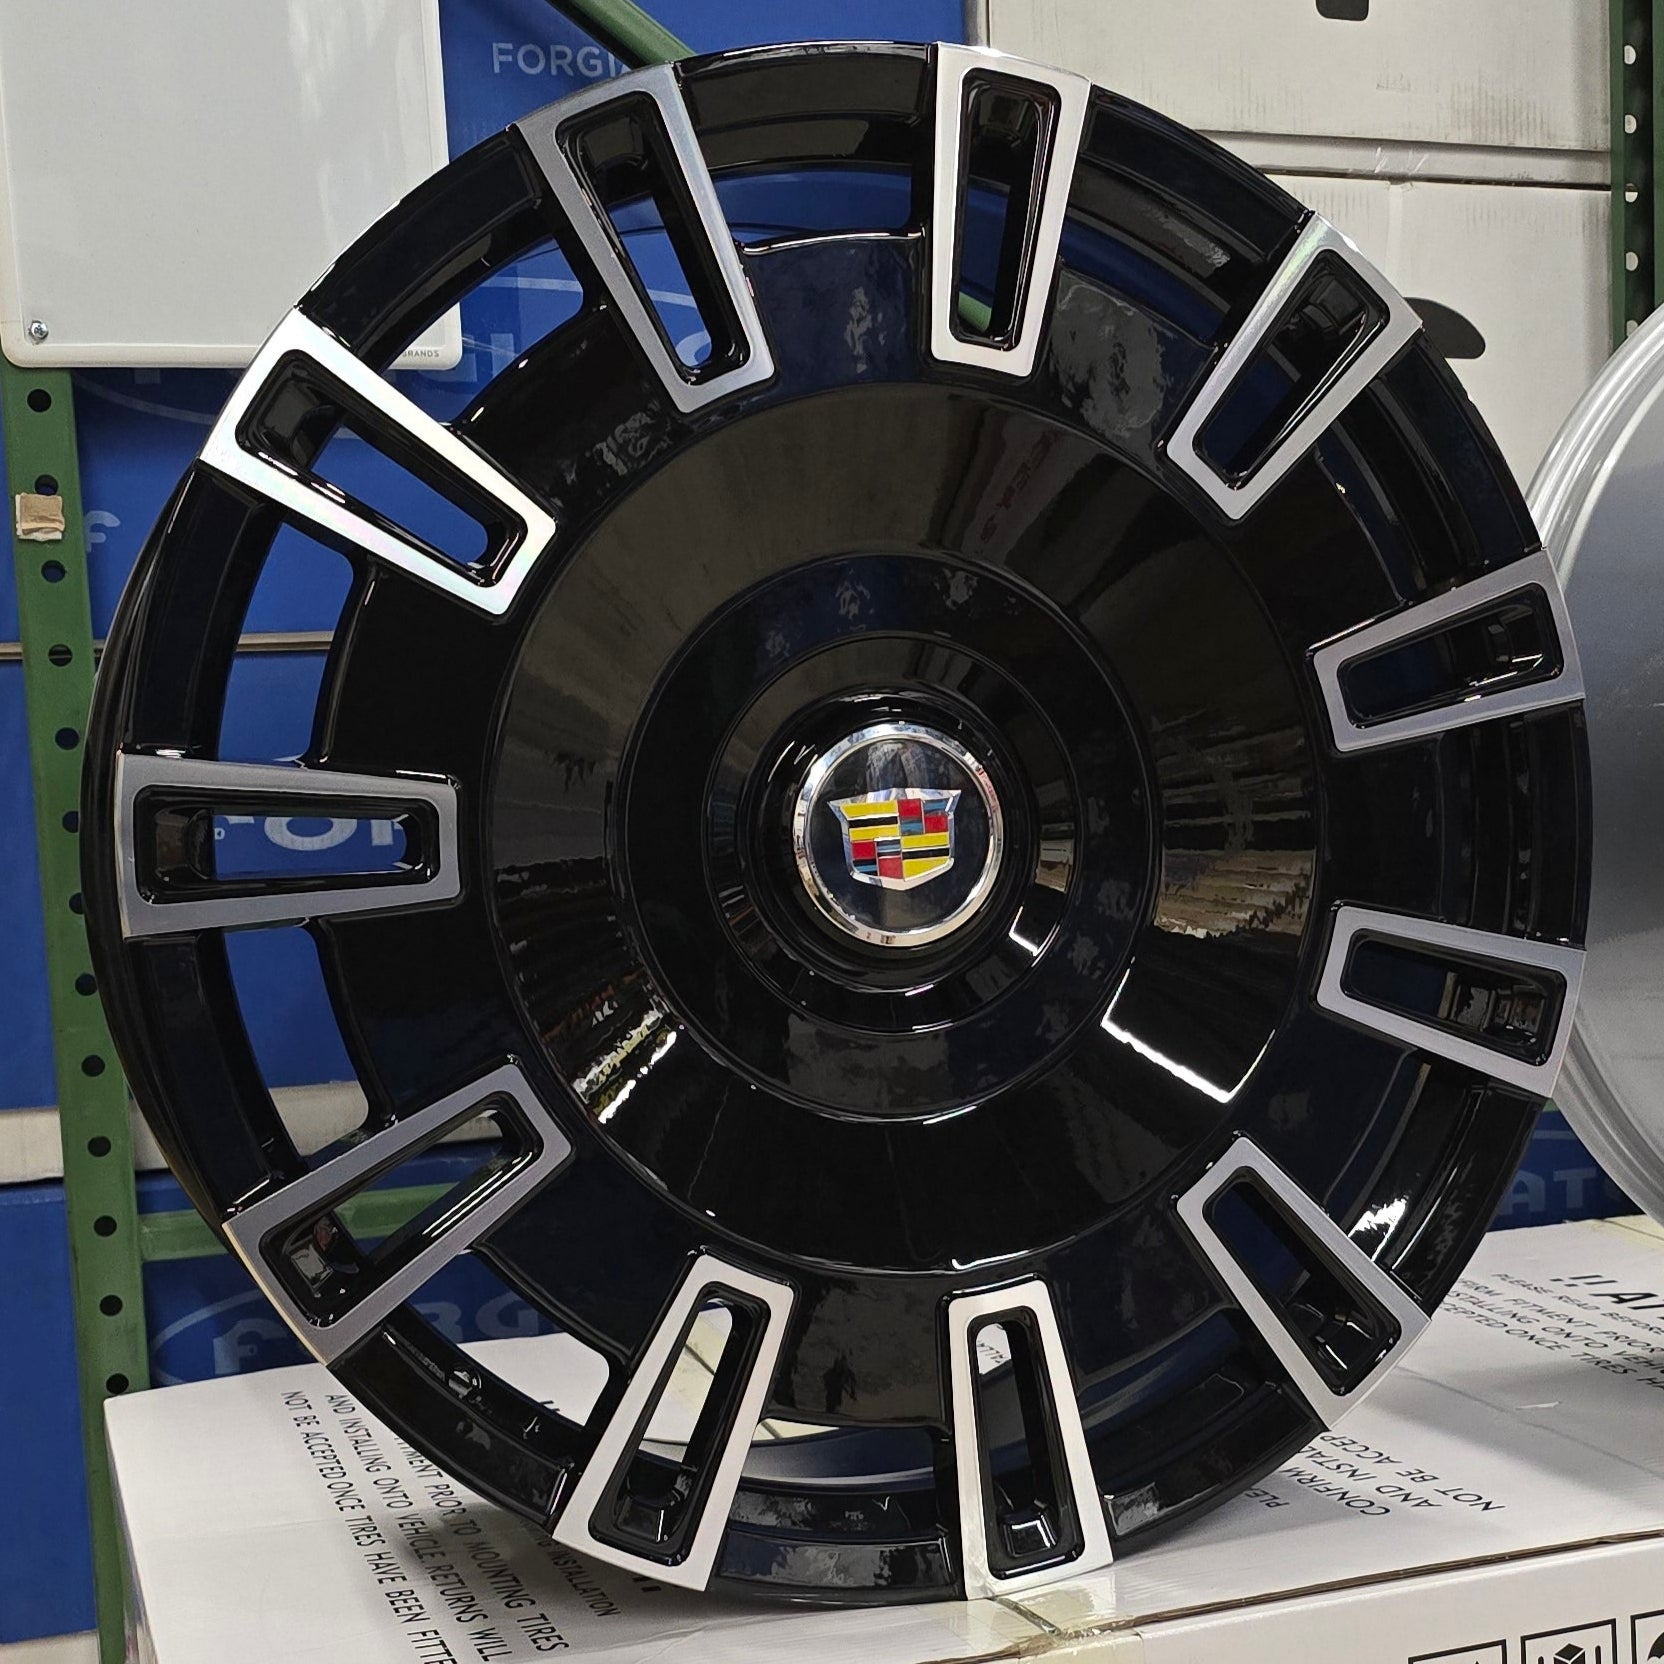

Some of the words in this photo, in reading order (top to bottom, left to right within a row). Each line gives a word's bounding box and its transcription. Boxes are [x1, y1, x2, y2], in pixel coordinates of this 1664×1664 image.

[492, 42, 632, 78] FORGI
[1503, 1298, 1598, 1328] FITMENT
[1600, 1312, 1664, 1335] BEFOR
[1505, 1328, 1571, 1350] ONCE
[1571, 1352, 1637, 1375] TIRES
[1541, 1326, 1608, 1348] ONTO
[281, 1391, 312, 1411] NOT
[325, 1394, 356, 1414] AND
[293, 1414, 320, 1427] BE
[301, 1432, 347, 1479] ACCEPTED
[339, 1417, 391, 1473] INSTALLING
[1279, 1466, 1391, 1516] CONFIRM
[1396, 1468, 1439, 1483] BE
[327, 1481, 365, 1512] ONCE
[373, 1477, 413, 1509] ONTO
[424, 1484, 467, 1516] PRIOR
[1375, 1484, 1442, 1508] AND
[1434, 1487, 1505, 1511] NOT
[345, 1515, 386, 1547] TIRES
[450, 1519, 482, 1536] TO
[364, 1551, 407, 1584] HAVE
[464, 1542, 536, 1609] MOUNTING
[385, 1589, 430, 1624] BEEN
[425, 1564, 489, 1623] RETURNS
[467, 1627, 513, 1662] WILL
[517, 1613, 570, 1652] TIRES
